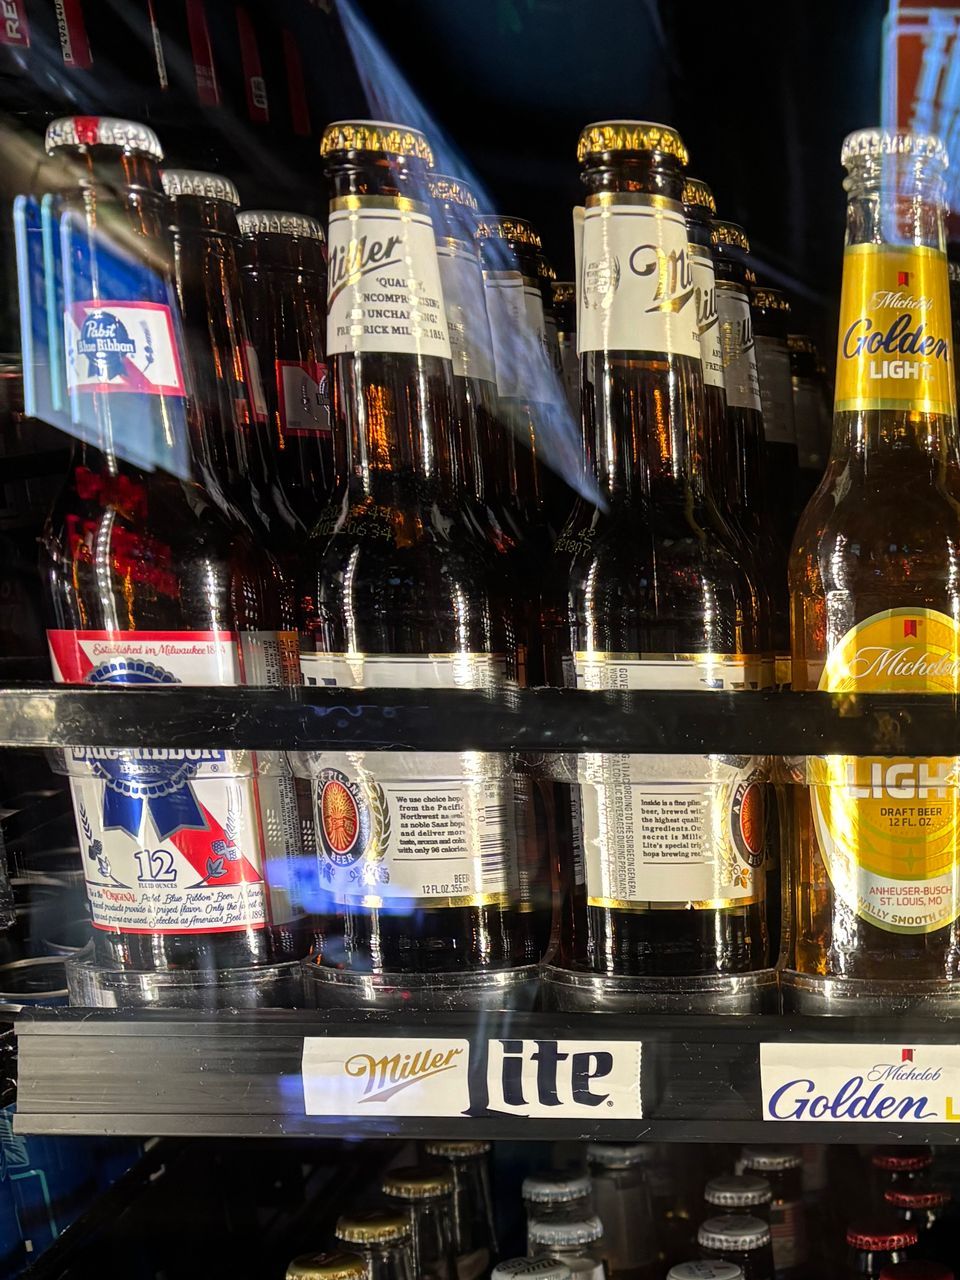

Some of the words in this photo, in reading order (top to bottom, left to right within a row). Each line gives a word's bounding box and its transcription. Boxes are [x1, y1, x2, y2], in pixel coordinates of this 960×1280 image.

[872, 290, 933, 312] Michelob
[85, 320, 119, 338] Pabst
[843, 313, 951, 362] Golden
[97, 338, 134, 352] Ribbon
[869, 360, 934, 381] LIGHT
[155, 643, 206, 656] Milwaukee
[399, 804, 418, 812] from
[421, 804, 435, 812] the
[641, 807, 660, 815] beer,
[661, 807, 689, 815] brewed
[880, 806, 916, 817] DRAFT
[917, 806, 943, 817] BEER
[410, 821, 430, 829] noble
[654, 816, 680, 824] highest
[888, 817, 899, 827] 12
[901, 817, 918, 827] FL.
[918, 817, 934, 827] OZ.
[400, 829, 415, 837] and
[417, 829, 445, 837] deliver
[414, 847, 430, 855] only
[642, 841, 663, 849] Lite's
[664, 842, 689, 850] special
[642, 850, 660, 858] hops
[661, 850, 690, 858] brewing
[134, 849, 177, 882] 12
[627, 867, 637, 897] GENERAL
[422, 885, 431, 894] 12
[869, 884, 953, 896] ANHEUSER-BUSCH
[879, 896, 895, 906] ST.
[895, 896, 927, 907] LOUIS,
[928, 895, 943, 906] MO
[890, 911, 937, 926] SMOOTH
[344, 1047, 464, 1100] Miller
[461, 1039, 614, 1118] Lite
[867, 1063, 942, 1082] Michelob
[768, 1075, 938, 1121] Golden
